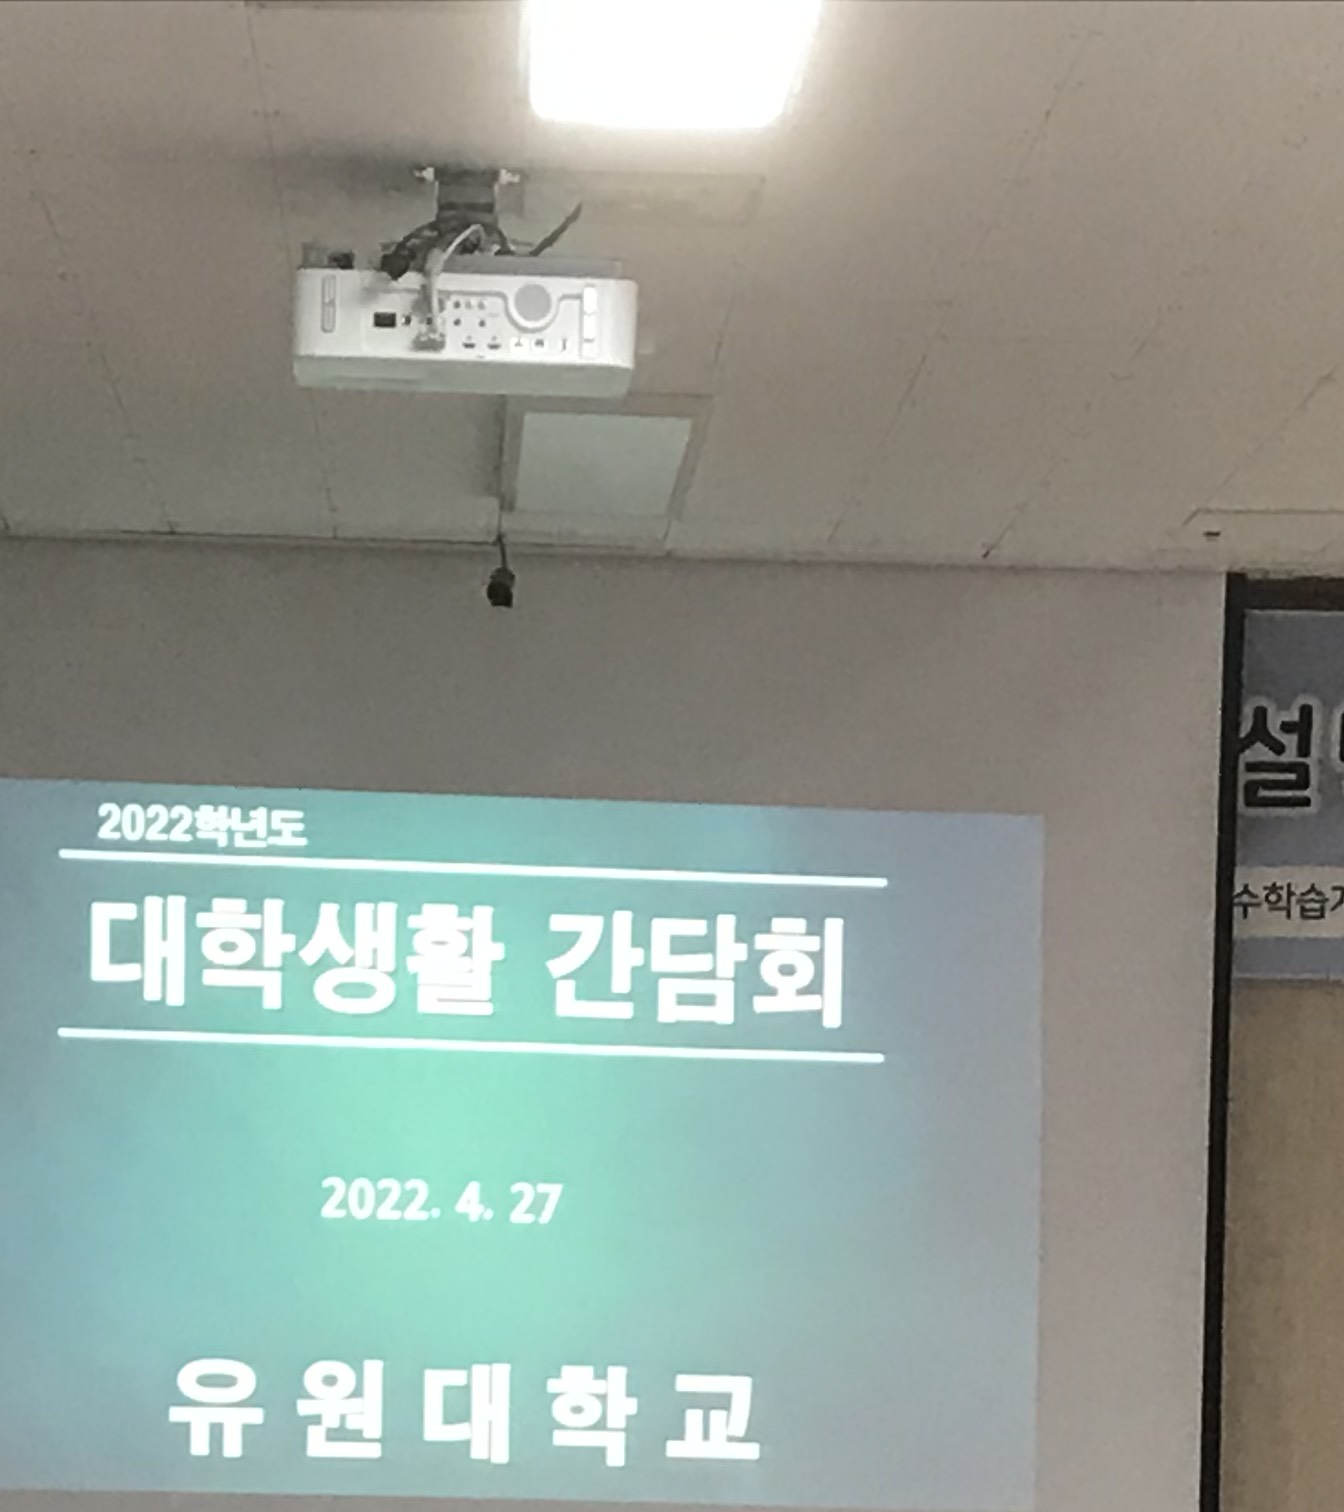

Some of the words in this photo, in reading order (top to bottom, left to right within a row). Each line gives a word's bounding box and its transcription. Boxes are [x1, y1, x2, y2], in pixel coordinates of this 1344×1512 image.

[97, 802, 308, 848] 2022학년도
[90, 895, 505, 1016] 대학생활
[545, 910, 844, 1029] 간담회
[320, 1176, 441, 1221] 2022.
[454, 1180, 494, 1223] 4.
[509, 1181, 564, 1225] 27
